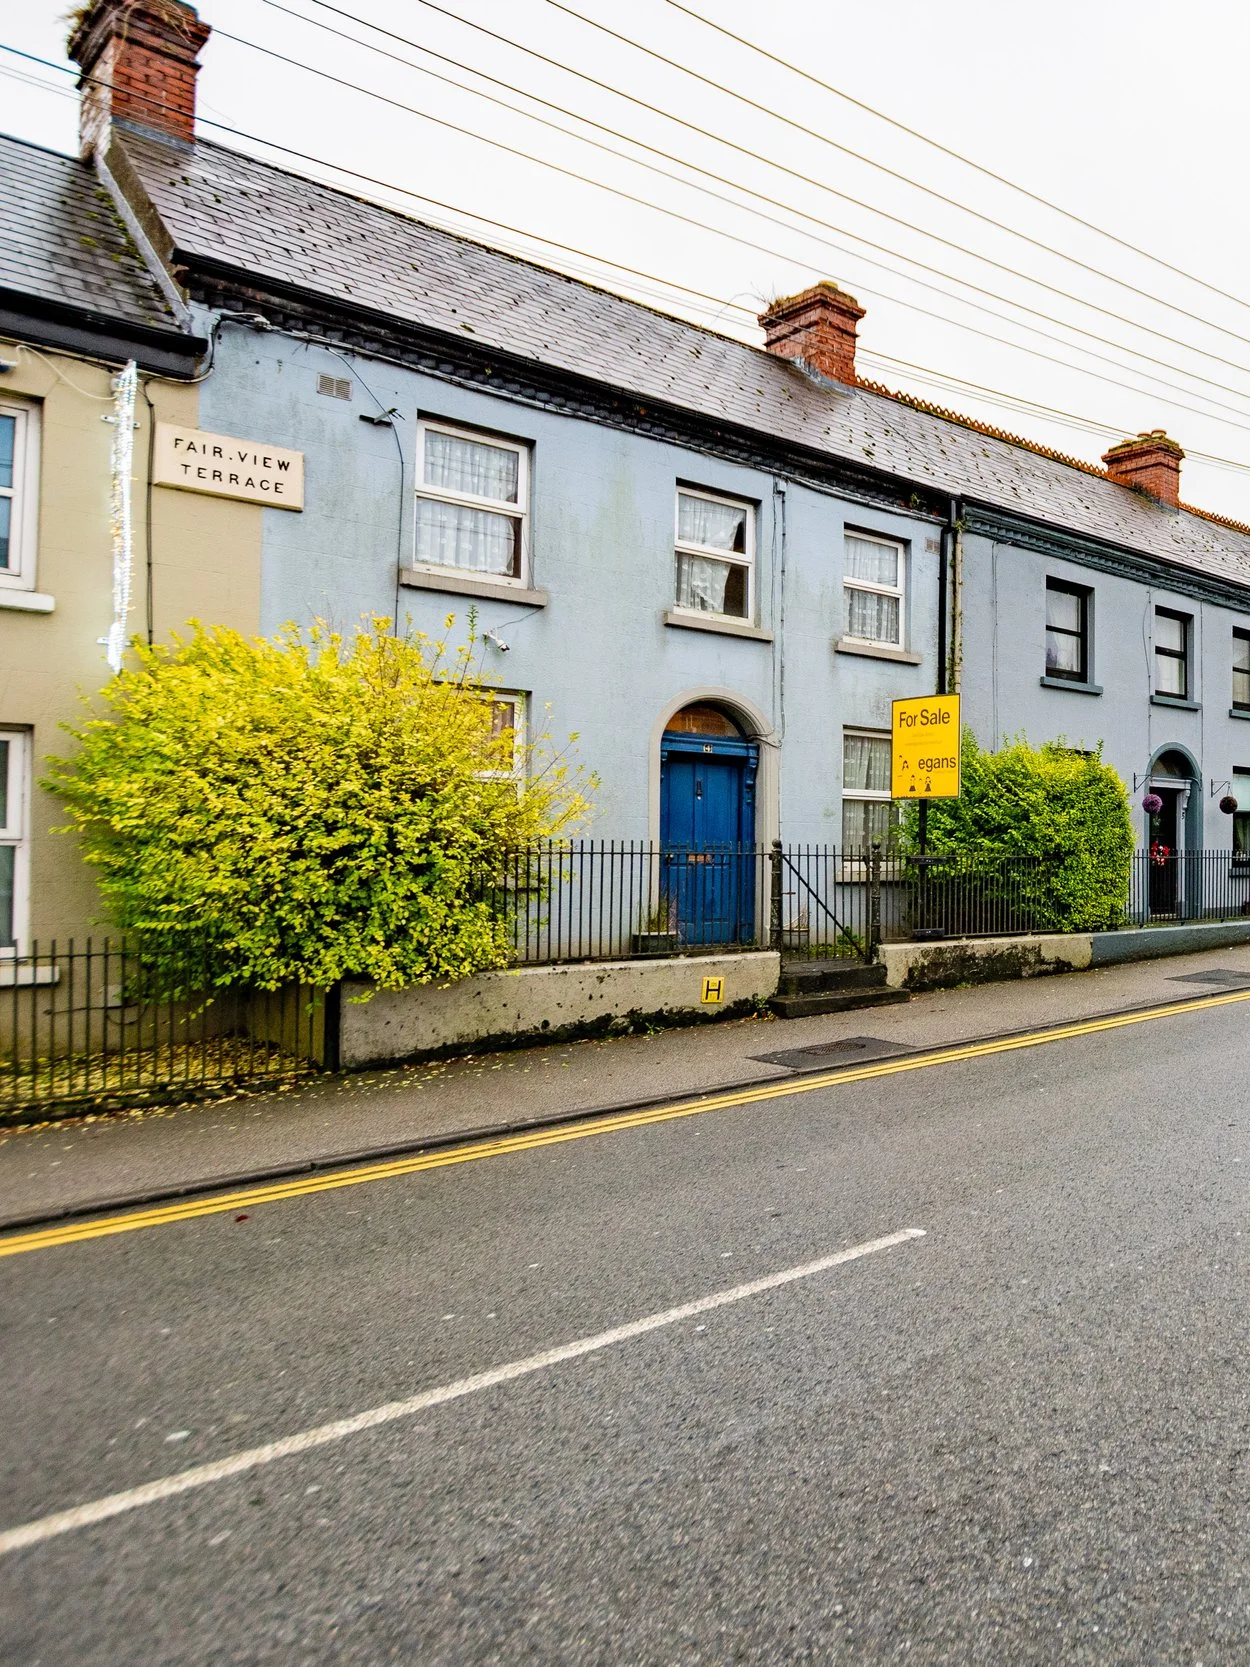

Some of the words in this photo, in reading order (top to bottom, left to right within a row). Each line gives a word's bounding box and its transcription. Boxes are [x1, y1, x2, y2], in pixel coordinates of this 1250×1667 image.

[181, 463, 284, 494] TERRACE
[899, 711, 918, 728] For
[920, 708, 950, 726] Sale
[705, 980, 721, 1000] H
